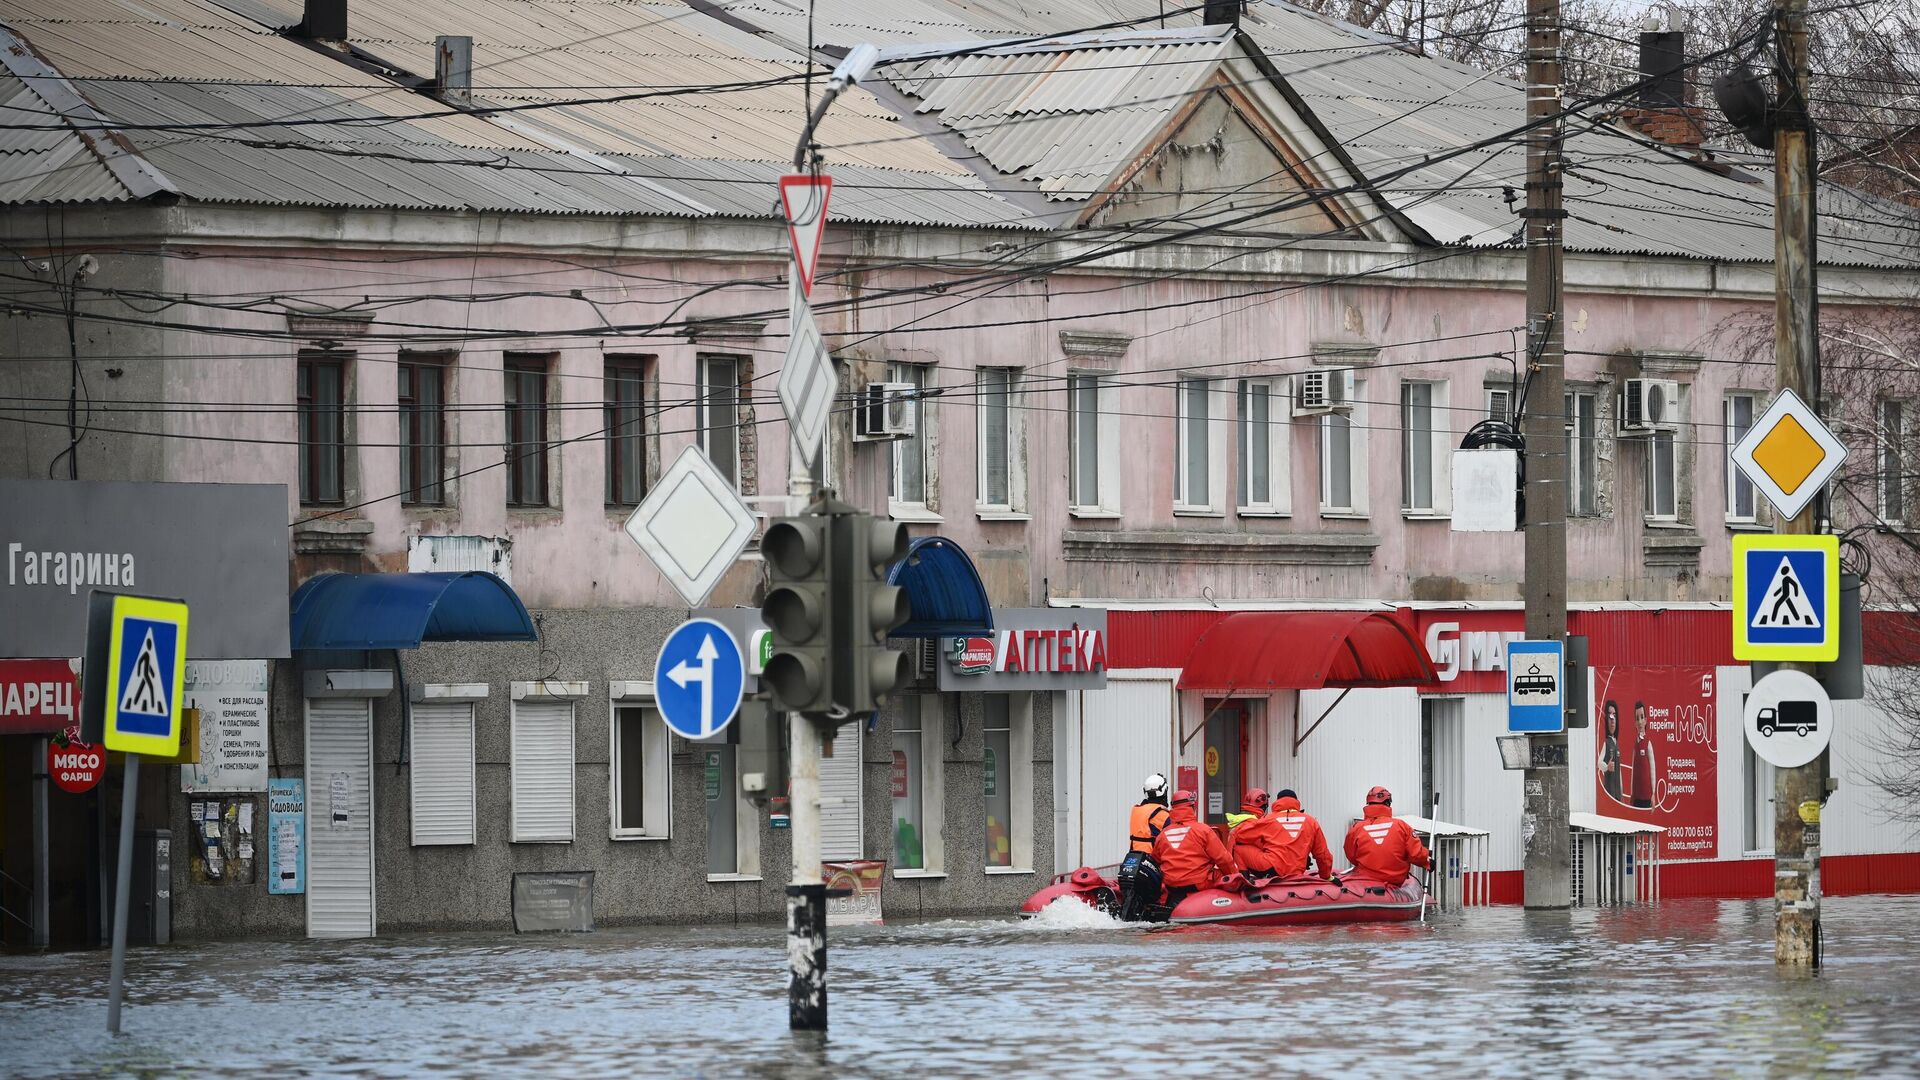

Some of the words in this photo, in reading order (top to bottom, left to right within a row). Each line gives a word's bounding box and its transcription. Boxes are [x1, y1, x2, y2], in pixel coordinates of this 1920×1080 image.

[8, 542, 135, 595] Гагарина
[1003, 629, 1108, 672] АПТЕКА
[960, 652, 992, 663] ФАРМЛЕНД
[0, 682, 74, 721] АРЕЦ
[222, 697, 232, 705] ВСЕ
[242, 697, 264, 706] РАССАДЫ
[222, 710, 257, 718] КЕРАМИЧЕСКИЕ
[1649, 705, 1669, 719] Время
[1649, 719, 1675, 732] перейти
[222, 729, 242, 737] ГОРШКИ
[1666, 732, 1675, 742] на
[243, 740, 261, 748] ГРУНТЫ
[223, 750, 250, 758] УДОБРЕНИЯ
[54, 753, 100, 769] МЯСО
[223, 762, 260, 770] КОНСУЛЬТАЦИИ
[1667, 756, 1696, 768] Продавец
[60, 771, 93, 782] ФАРШ
[1666, 769, 1698, 782] Товаровед
[1667, 783, 1696, 795] Директор
[270, 798, 303, 813] Садовода
[1672, 826, 1684, 838] 800
[1684, 826, 1697, 838] 700
[1696, 826, 1705, 837] 63
[1704, 825, 1713, 837] 03
[1667, 839, 1713, 852] rabota.magnit.ru
